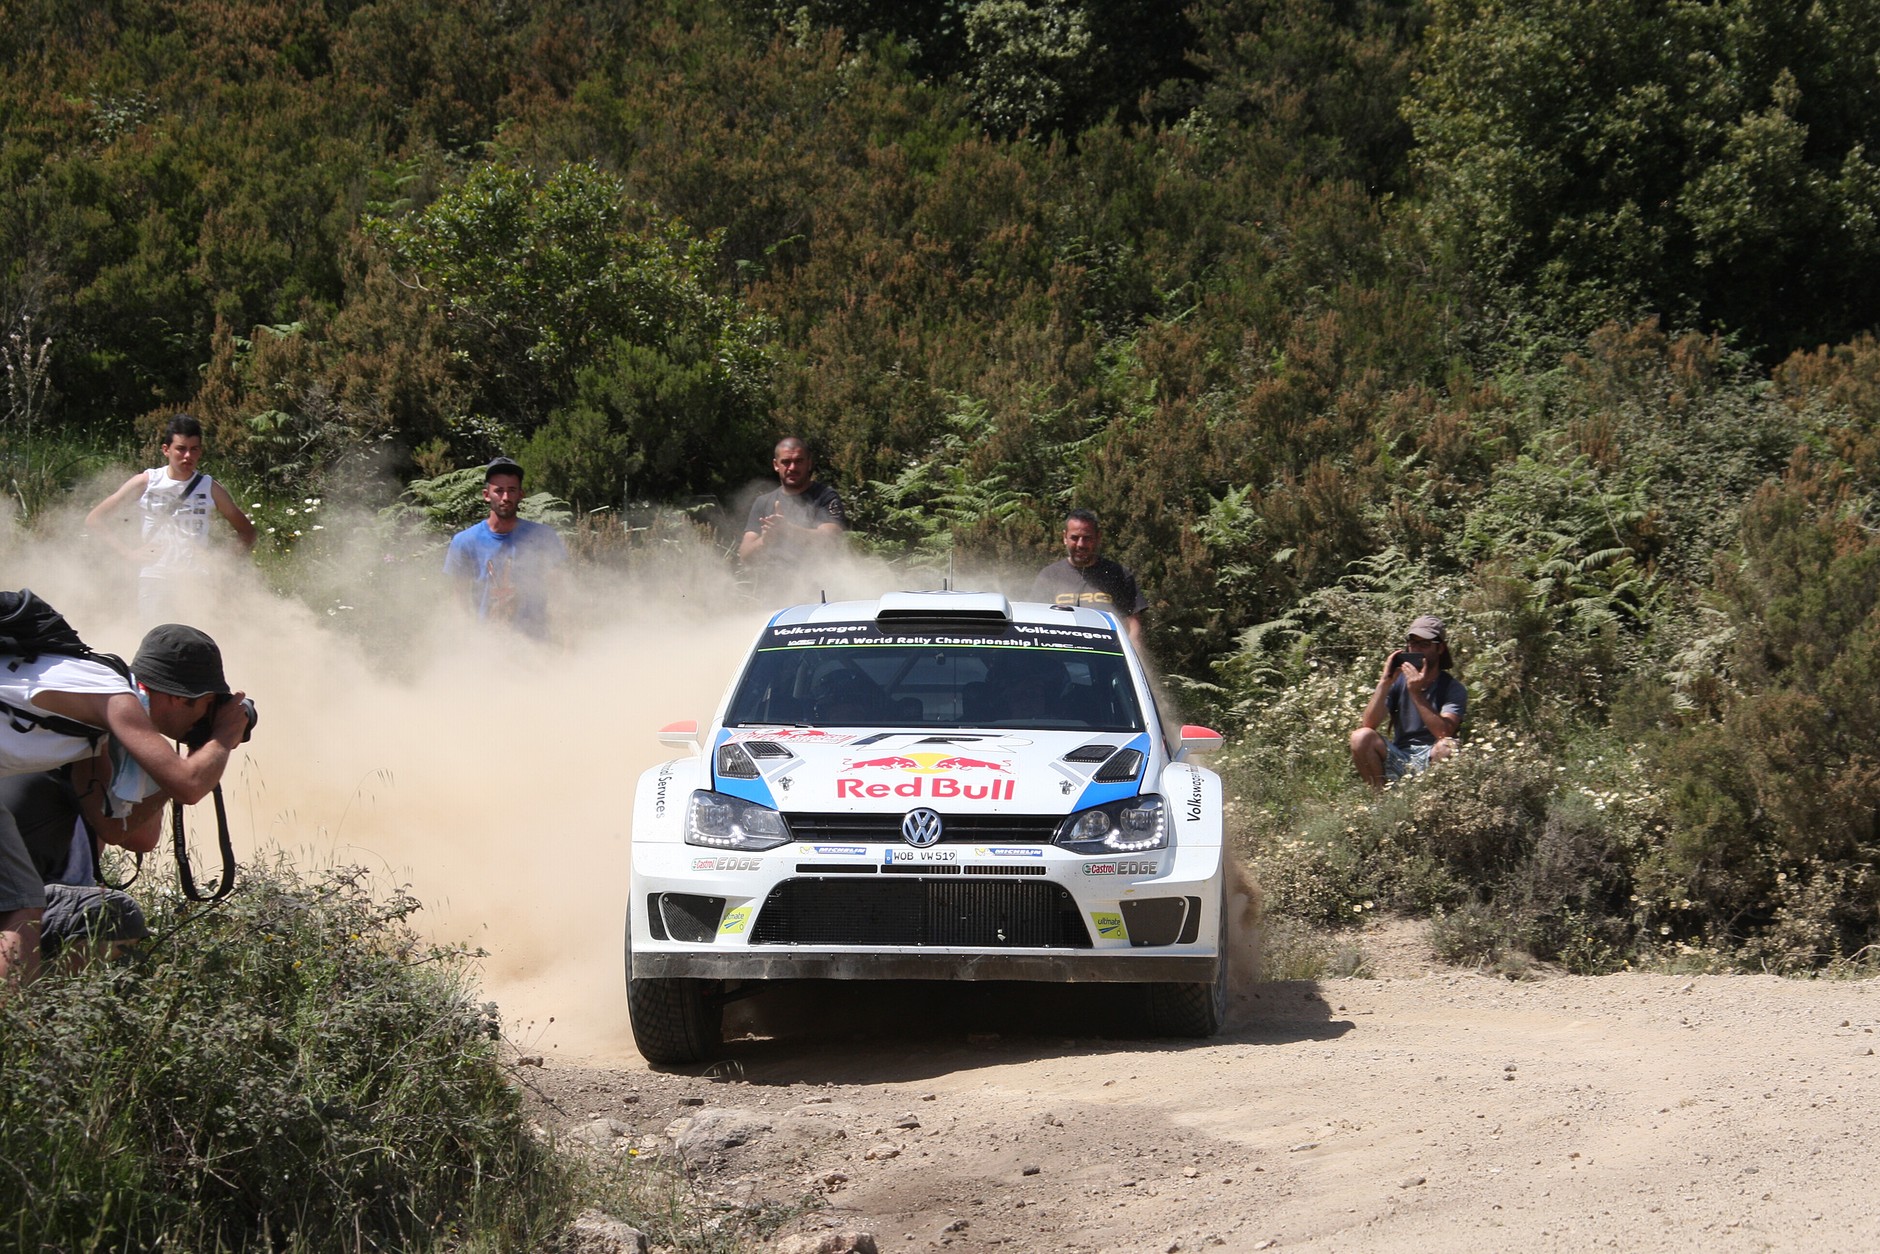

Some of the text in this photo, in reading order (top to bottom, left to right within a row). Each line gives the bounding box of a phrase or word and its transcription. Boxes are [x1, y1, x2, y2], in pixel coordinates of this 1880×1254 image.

[773, 625, 868, 636] Volkswagen
[1014, 625, 1112, 640] Volkswagen
[853, 637, 893, 645] World
[895, 637, 931, 645] Rally
[935, 637, 1031, 647] Championship
[837, 777, 1015, 800] Red Bull
[656, 776, 673, 819] Services
[894, 852, 914, 861] WOB
[716, 857, 764, 871] EDGE
[1092, 861, 1158, 875] Castrol EDGE
[1097, 917, 1121, 926] ultimate
